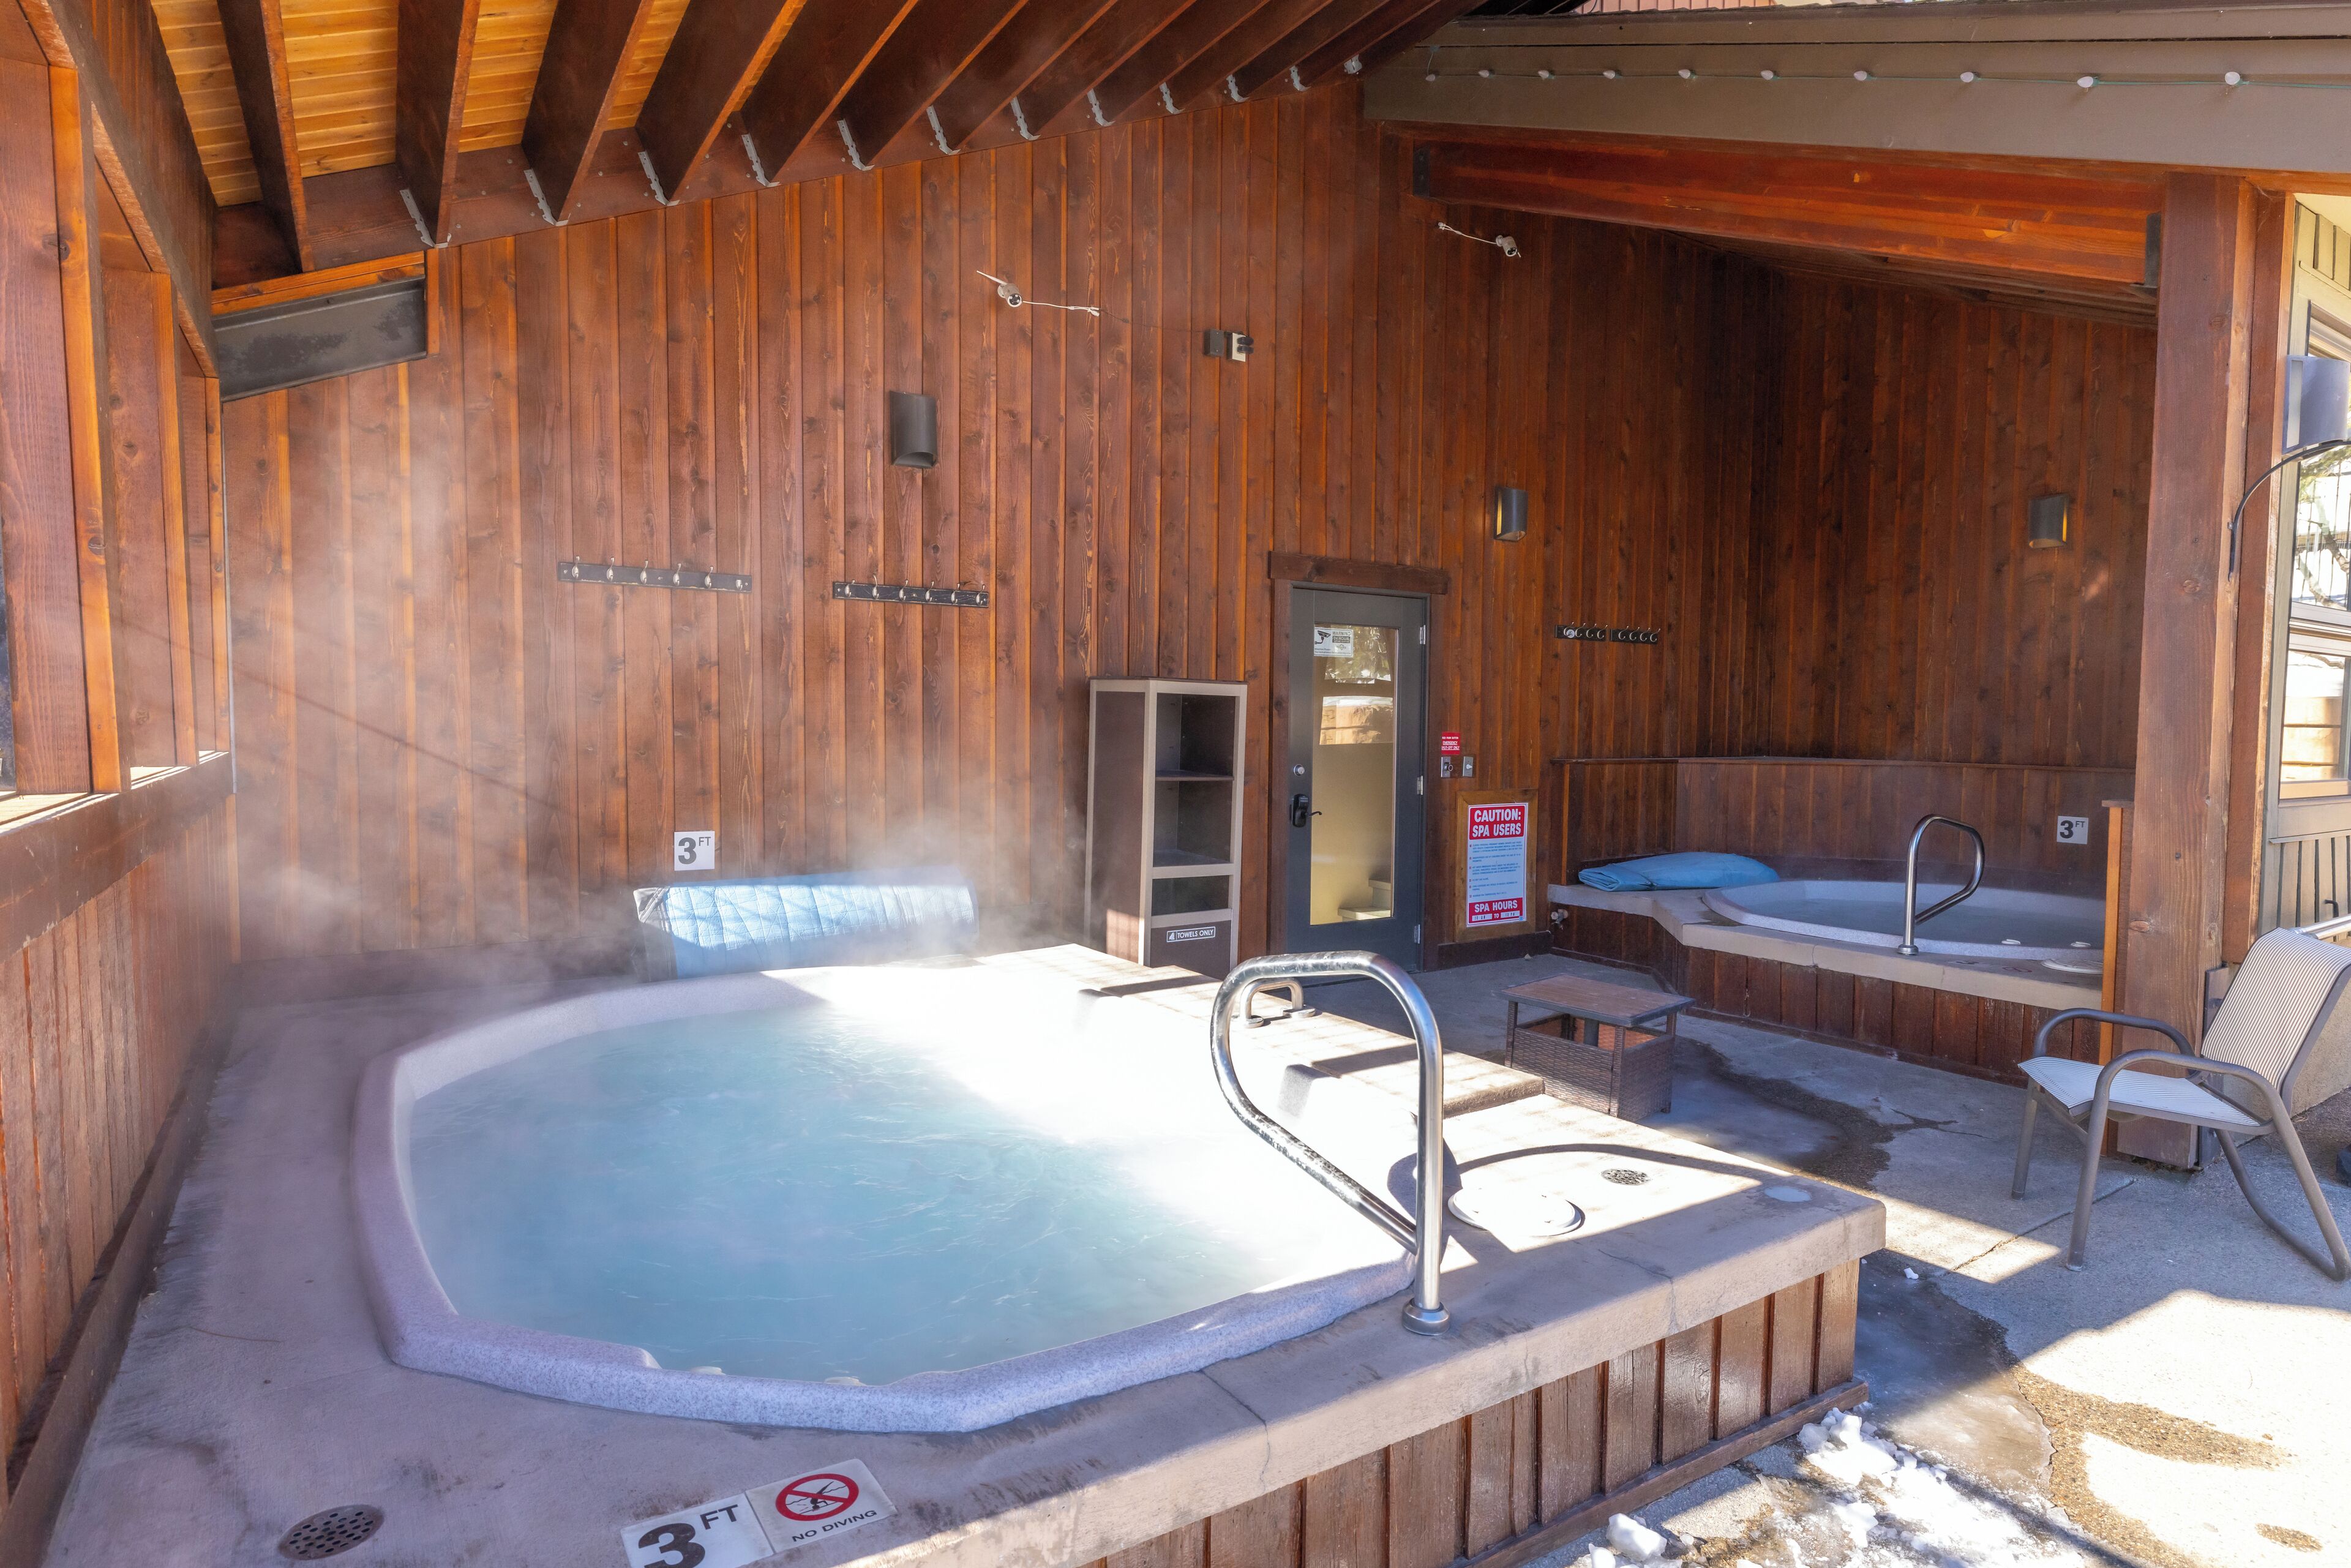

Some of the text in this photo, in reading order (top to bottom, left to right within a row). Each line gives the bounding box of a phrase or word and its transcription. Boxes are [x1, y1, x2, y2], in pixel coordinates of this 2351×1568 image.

[1474, 808, 1521, 823] CAUTION:
[1472, 822, 1521, 838] SPA USERS
[2059, 820, 2074, 839] 3
[678, 836, 711, 865] 3 FT
[1474, 899, 1518, 913] SPA HOURS
[792, 1509, 877, 1542] NO DIVING
[638, 1504, 738, 1568] 3 FT
